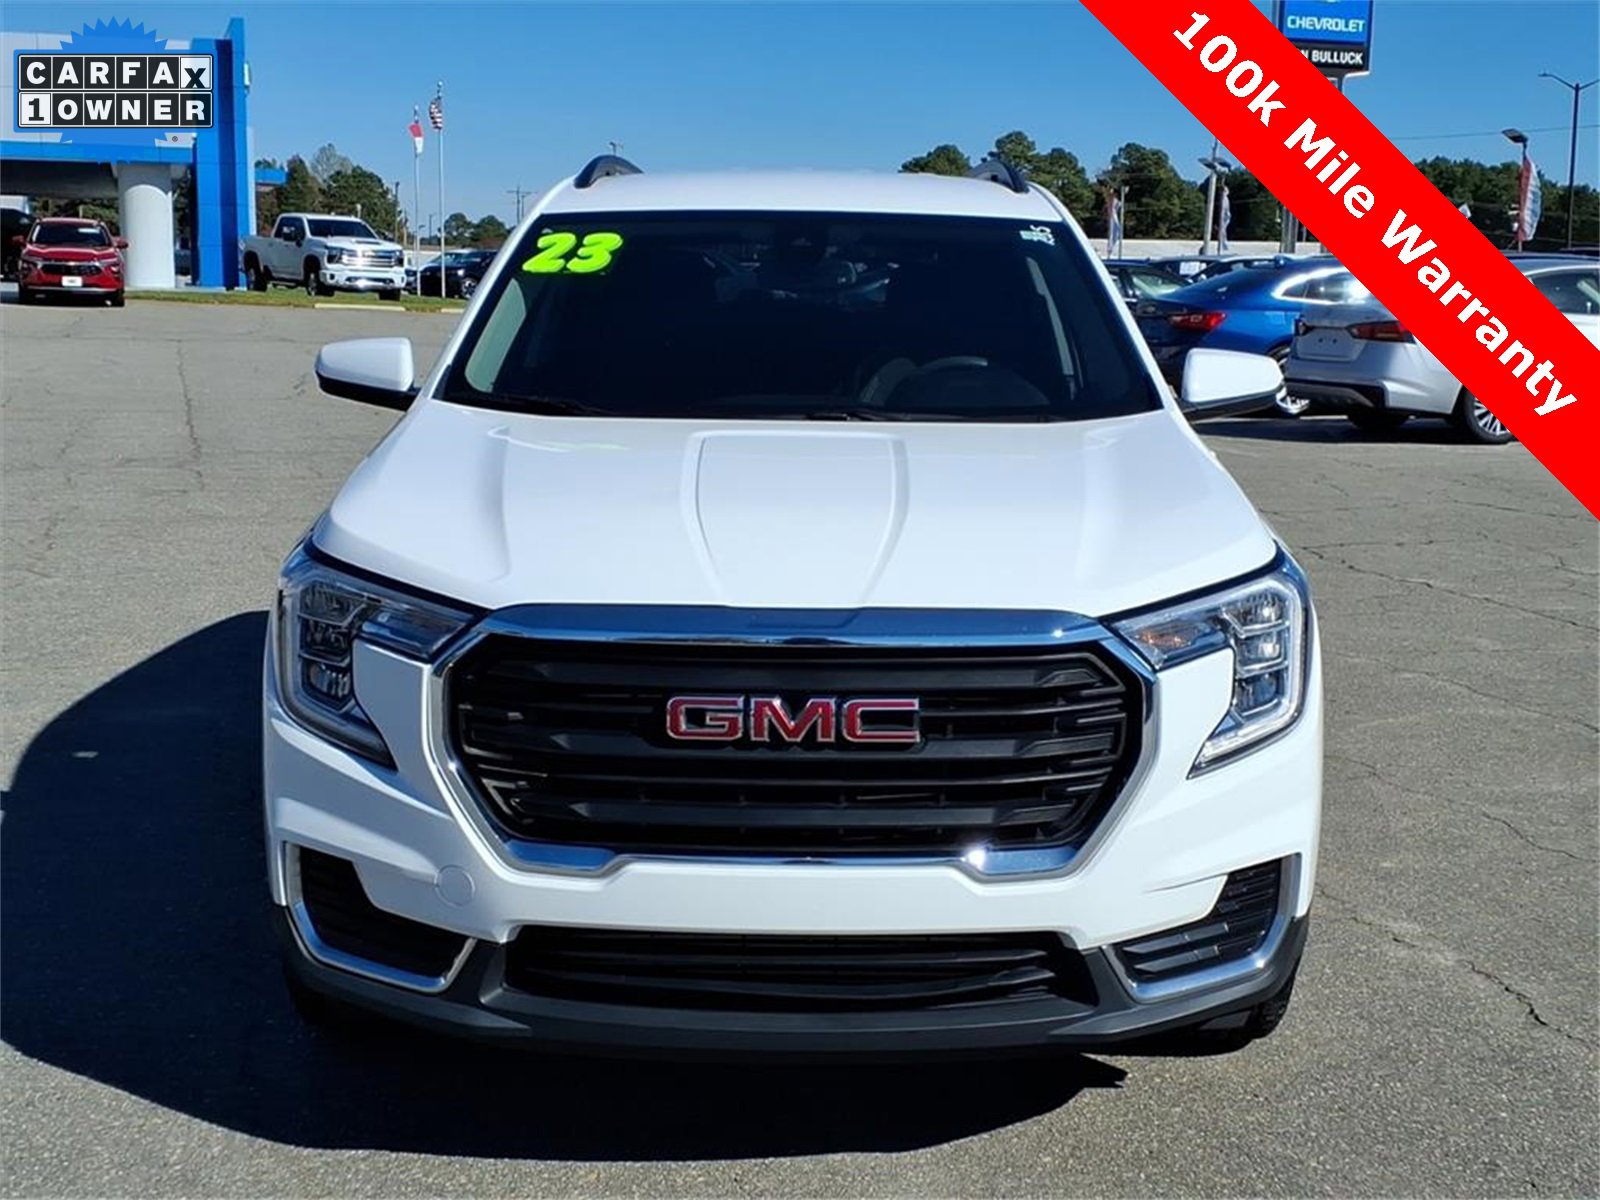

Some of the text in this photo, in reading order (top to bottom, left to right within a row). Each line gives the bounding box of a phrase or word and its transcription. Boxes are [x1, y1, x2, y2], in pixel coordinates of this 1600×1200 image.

[1286, 15, 1365, 33] CHEVROLET
[1311, 49, 1364, 65] BULLUCK
[522, 232, 624, 273] 23
[666, 696, 920, 743] GMC
